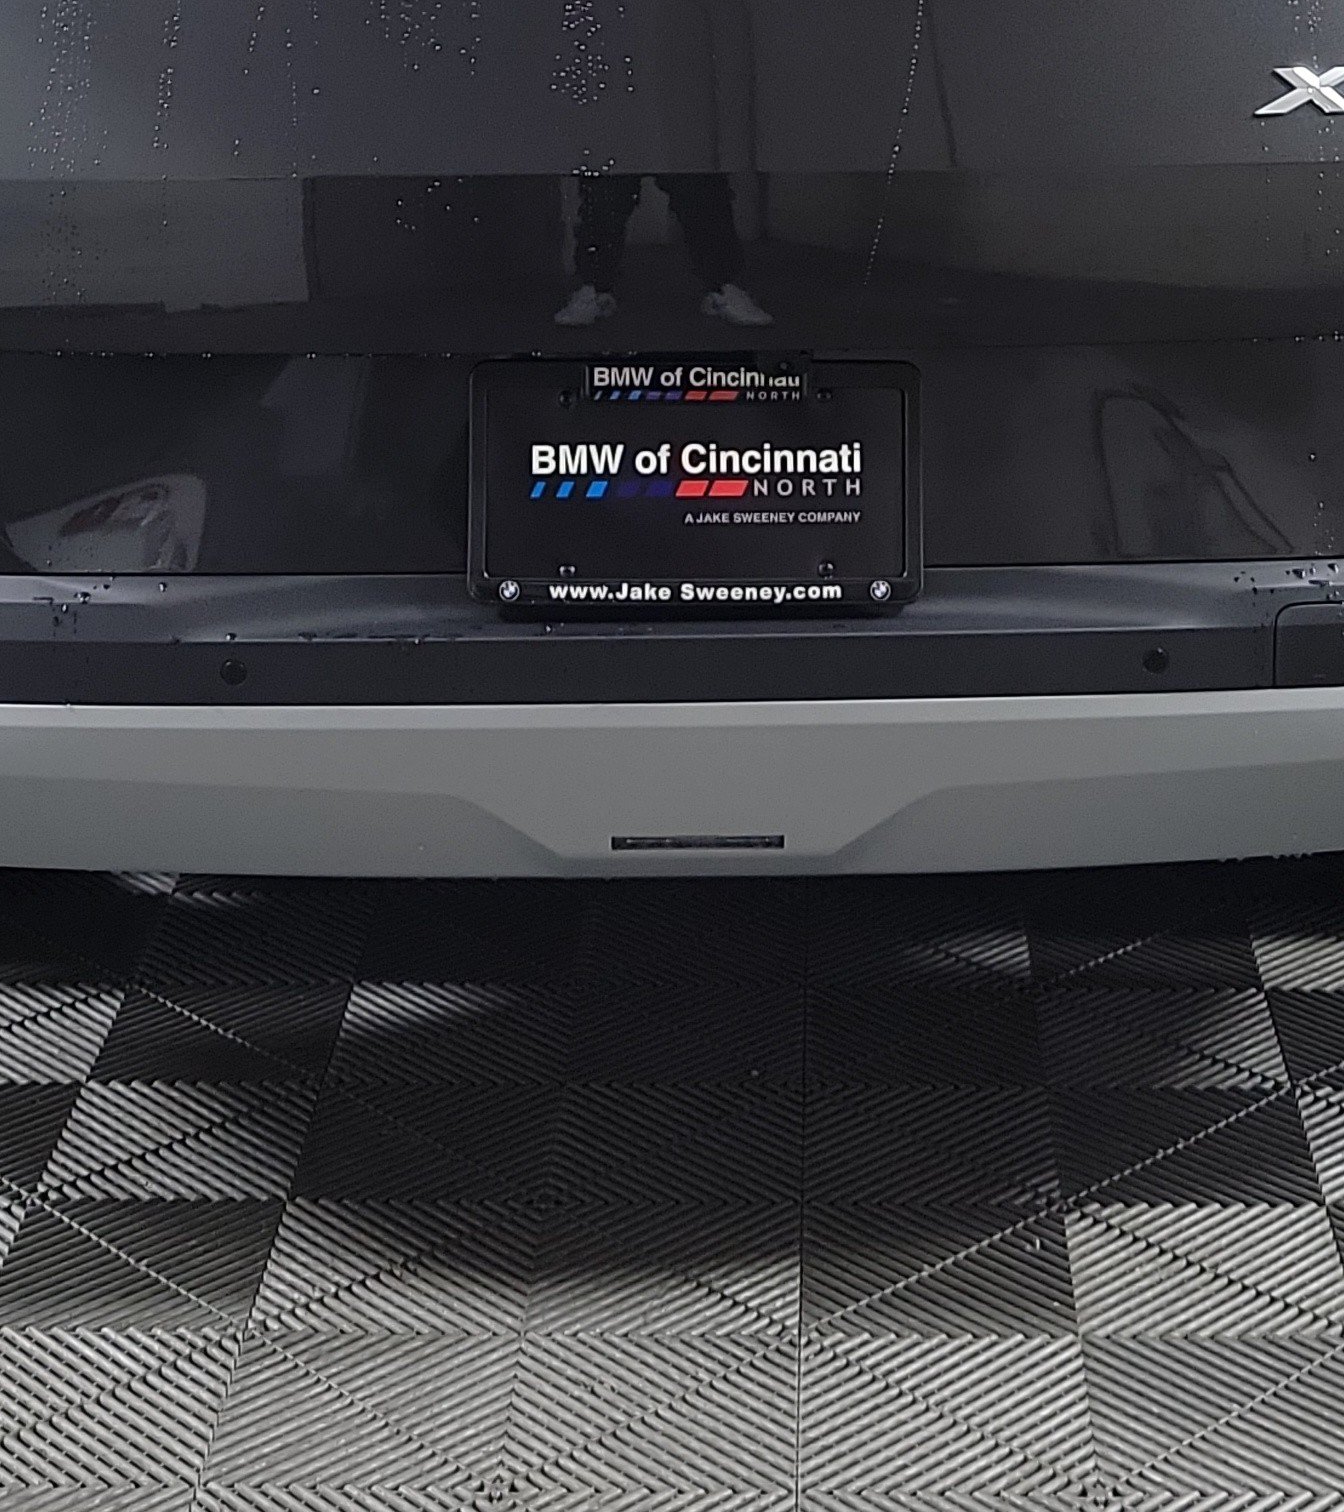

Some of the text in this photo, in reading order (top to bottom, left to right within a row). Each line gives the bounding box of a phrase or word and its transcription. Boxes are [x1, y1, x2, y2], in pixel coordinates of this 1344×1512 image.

[593, 367, 654, 387] BMW
[660, 367, 683, 387] of
[746, 391, 800, 400] NORTH
[531, 443, 862, 475] BMW of Cincinnati
[753, 478, 861, 496] NORTH
[684, 512, 861, 524] A JAKE SWEENEY COMPANY
[549, 583, 843, 603] www.Jake Sweeney.com
